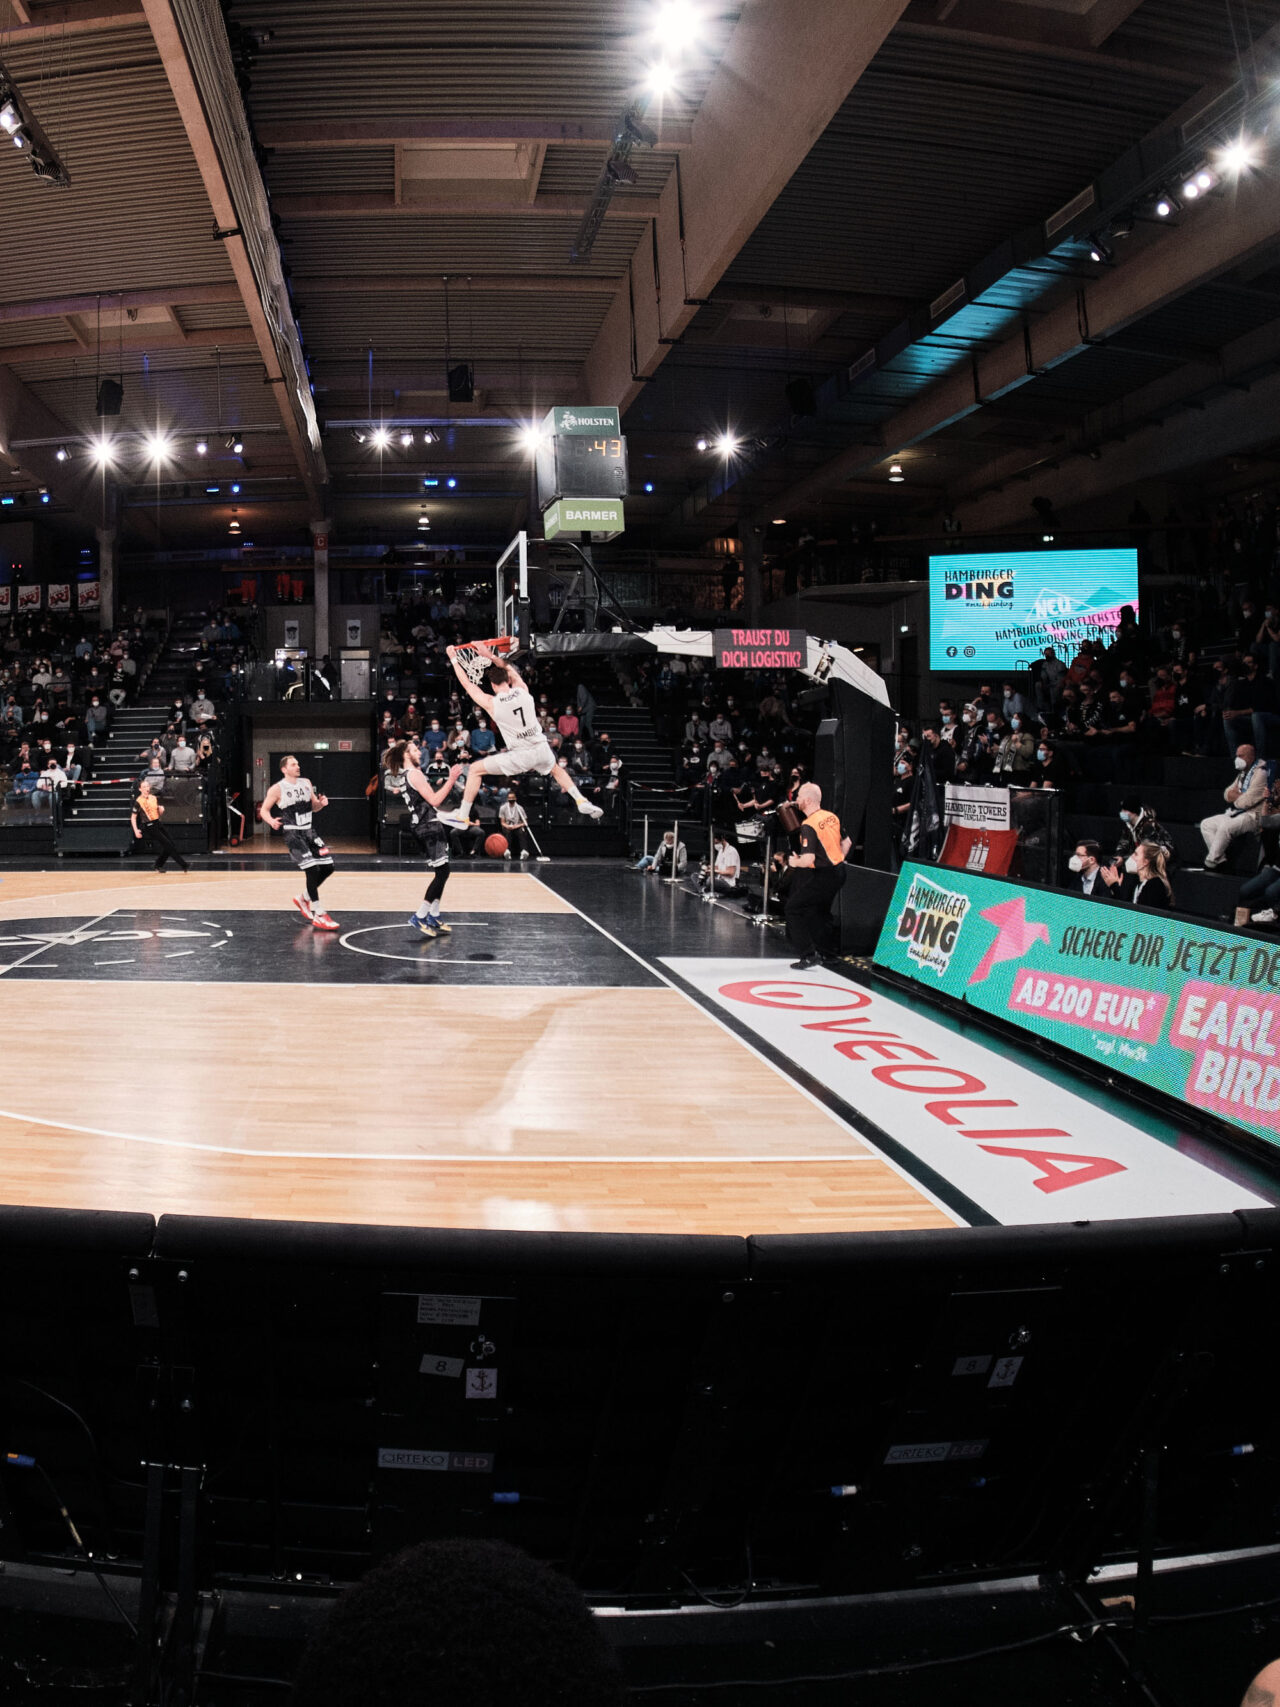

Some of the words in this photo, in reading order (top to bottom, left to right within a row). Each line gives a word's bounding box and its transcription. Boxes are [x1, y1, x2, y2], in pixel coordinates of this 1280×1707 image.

[578, 418, 614, 426] HOLSTEN
[566, 511, 618, 520] BARMER
[945, 569, 1014, 581] HAMBURGER
[945, 582, 1014, 600] DING
[1035, 599, 1072, 617] NEU
[731, 629, 772, 646] TRAUST
[774, 629, 790, 646] DU
[995, 623, 1048, 641] HAMBURGS
[1013, 628, 1083, 650] COOLWORKING
[722, 651, 748, 668] DICH
[750, 651, 801, 668] LOGISTIK?
[513, 706, 526, 727] 7
[945, 802, 976, 814] HAMBURG
[978, 805, 1007, 817] TOWERS
[908, 886, 967, 919] HAMBURGER
[898, 907, 960, 953] DING
[1058, 925, 1128, 963] SICHERE
[1128, 933, 1164, 967] DIR
[1166, 937, 1247, 982] JETZT
[1015, 977, 1049, 1008] AB
[1048, 982, 1093, 1019] 200
[800, 1017, 1128, 1194] VEOLIA
[435, 1360, 447, 1373] 8
[452, 1457, 489, 1469] LED
